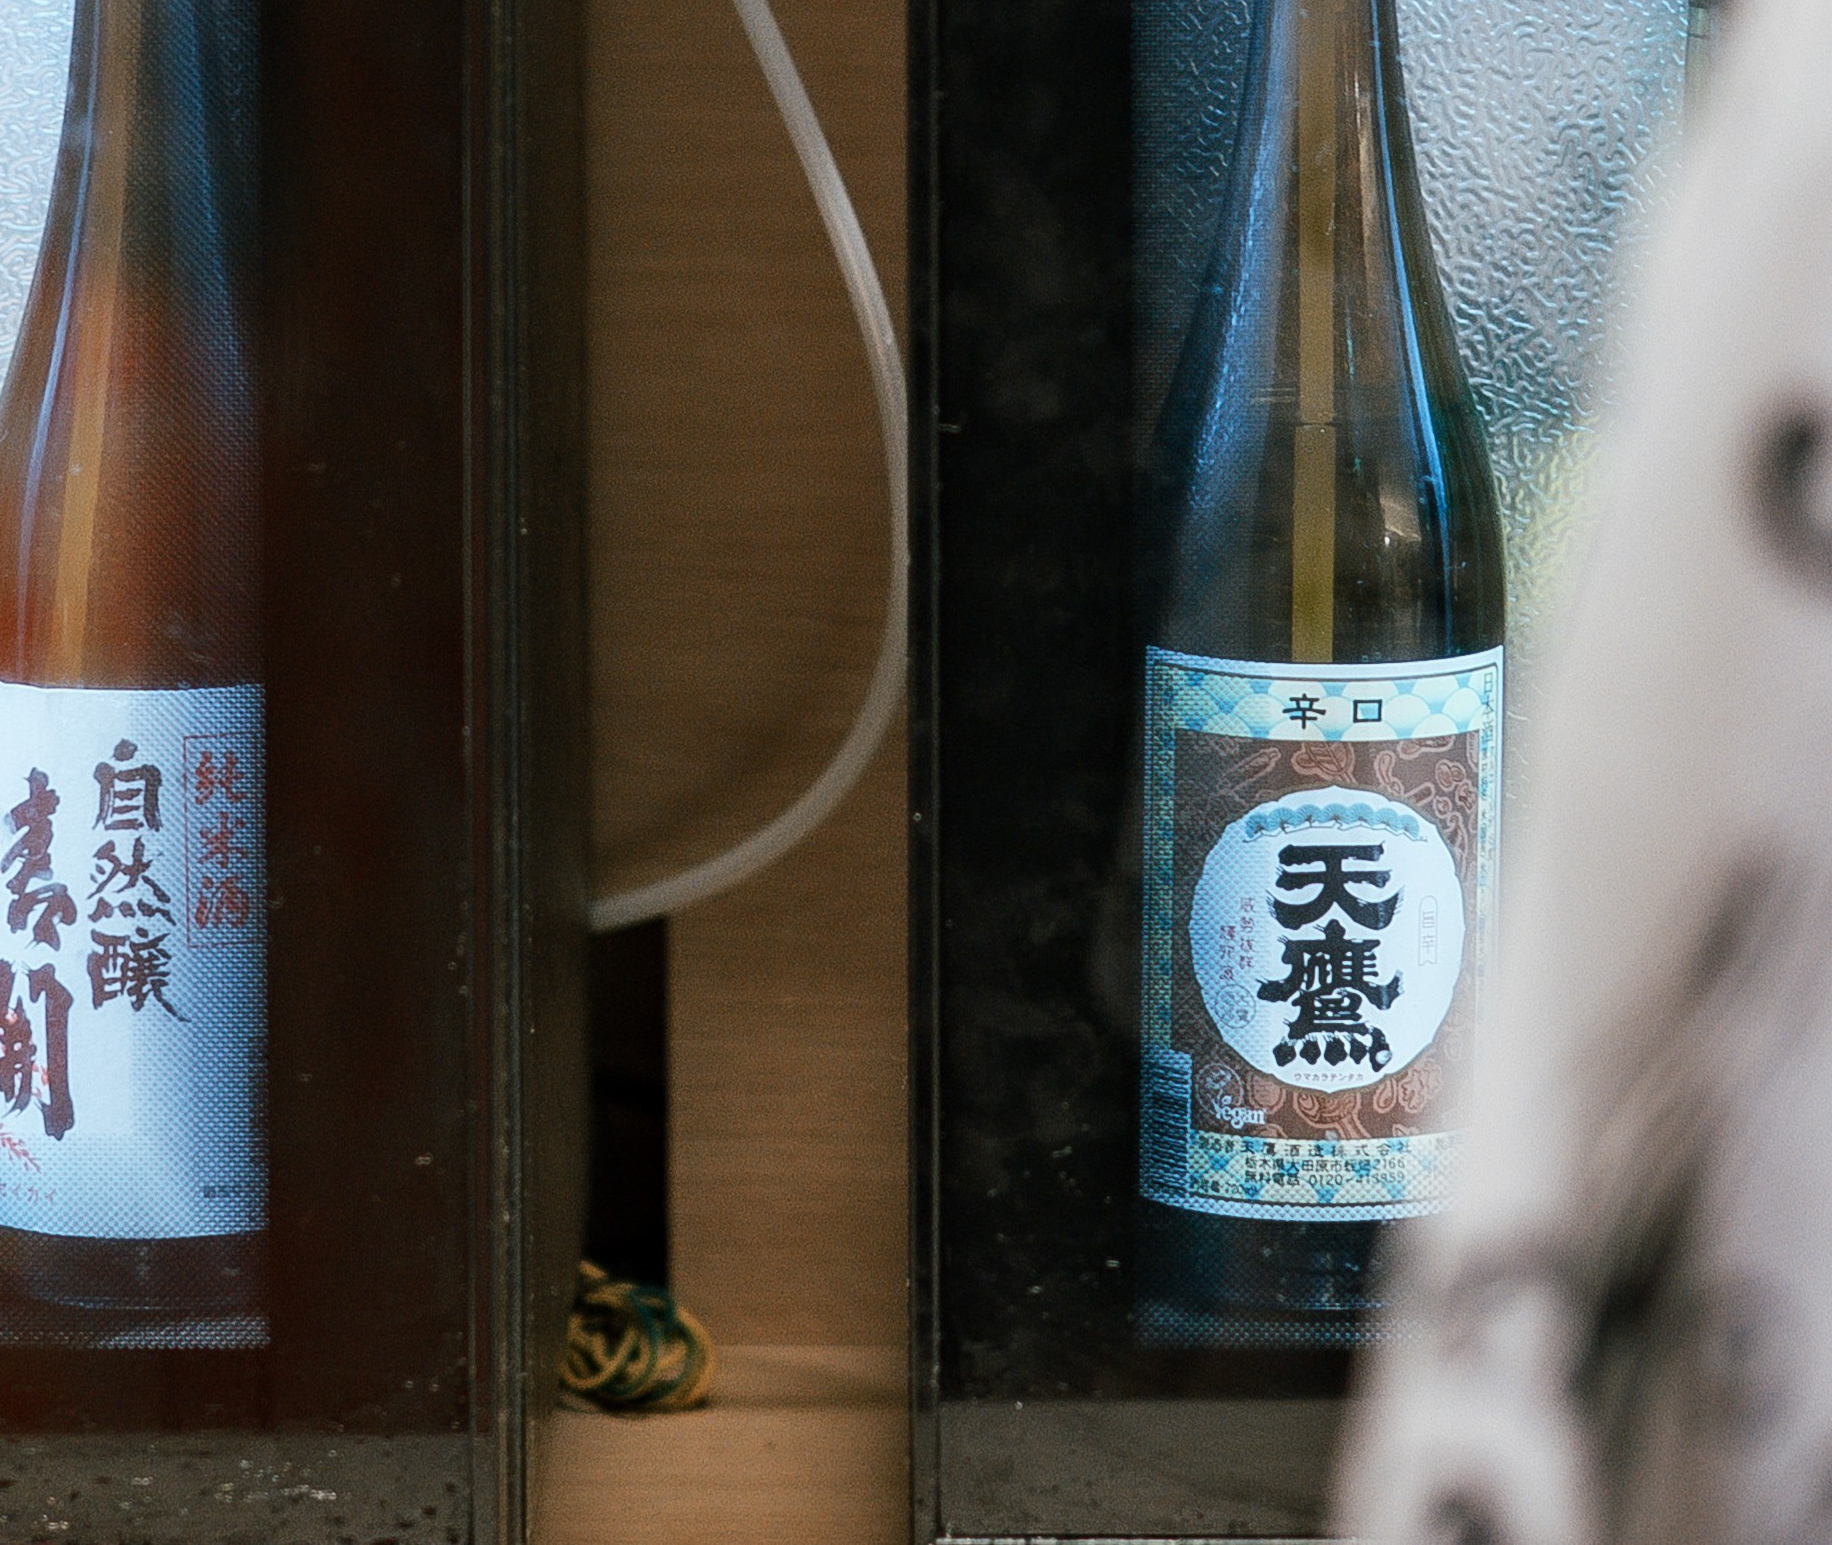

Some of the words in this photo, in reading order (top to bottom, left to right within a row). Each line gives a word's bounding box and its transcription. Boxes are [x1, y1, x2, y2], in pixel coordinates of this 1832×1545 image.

[1282, 693, 1384, 730] 辛口
[86, 738, 192, 1024] 自然醸
[192, 750, 252, 930] 純米酒
[1256, 843, 1404, 1073] 天鷹
